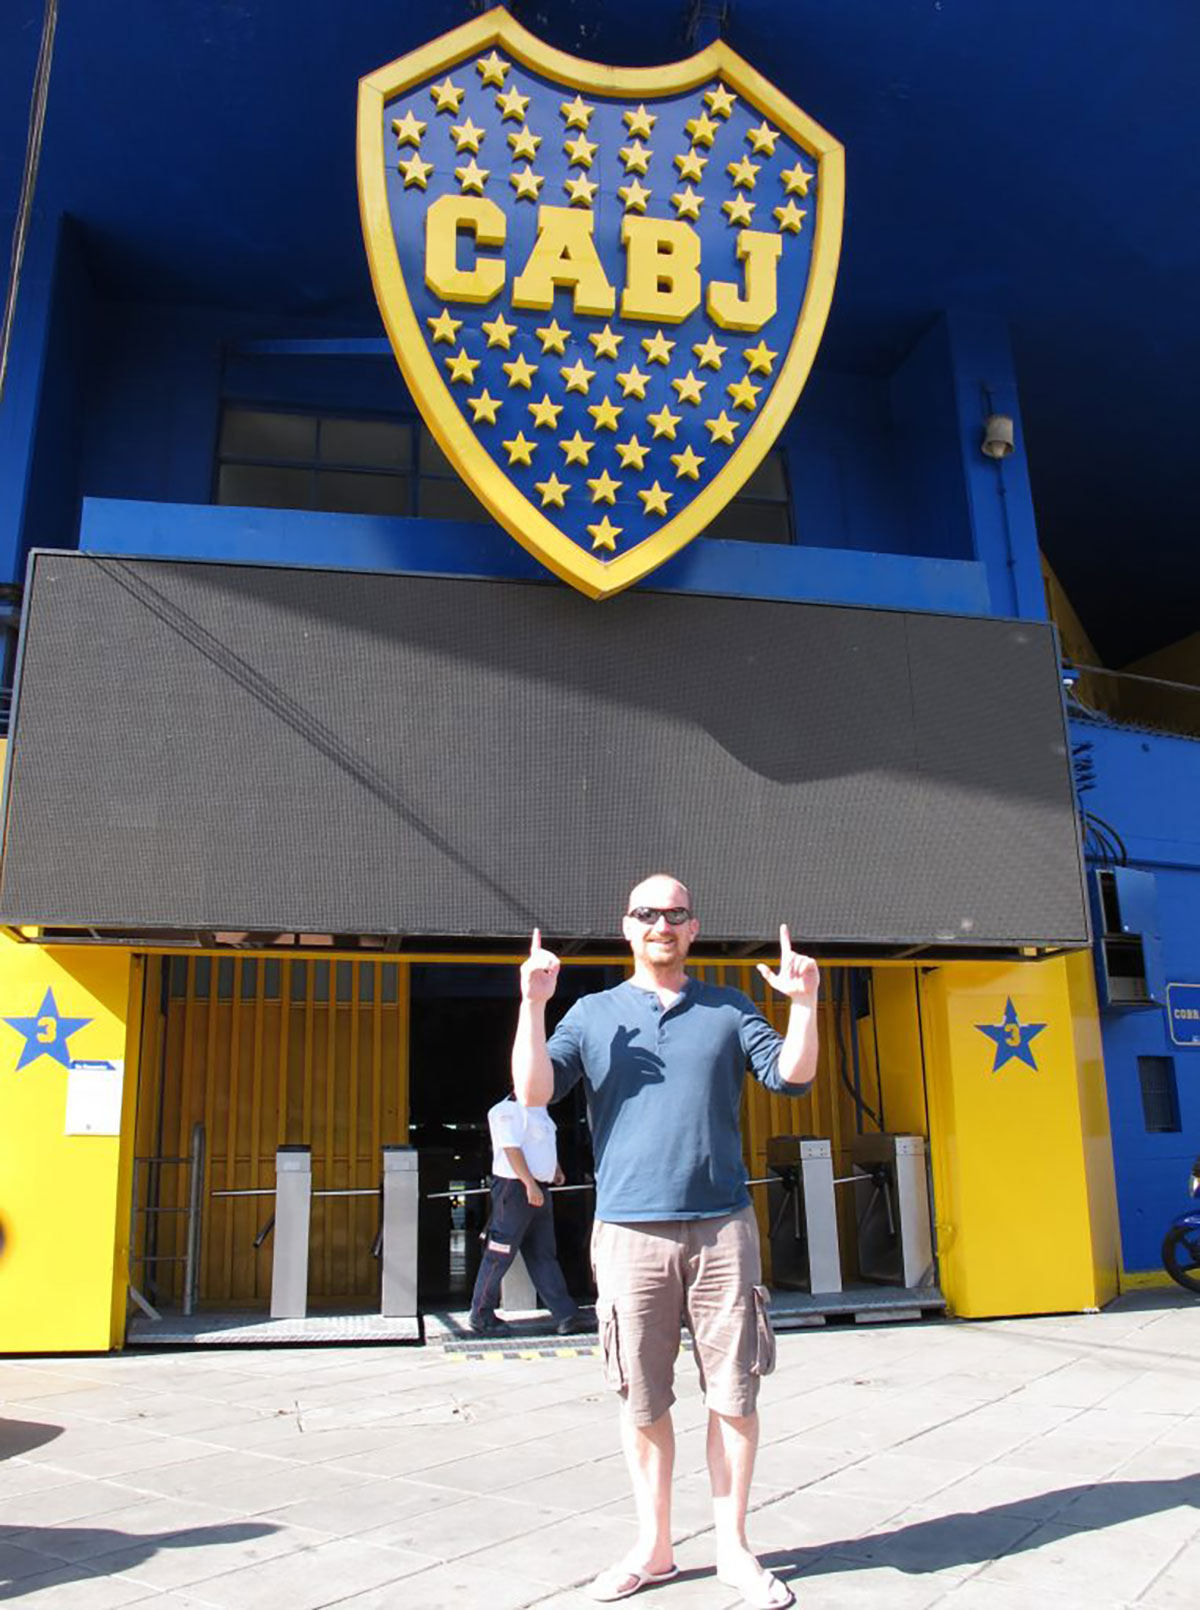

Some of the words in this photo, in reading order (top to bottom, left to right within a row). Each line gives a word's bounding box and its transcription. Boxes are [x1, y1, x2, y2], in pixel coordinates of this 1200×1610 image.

[425, 194, 782, 333] CABJ
[37, 1016, 58, 1044] 3
[1004, 1024, 1021, 1047] 3
